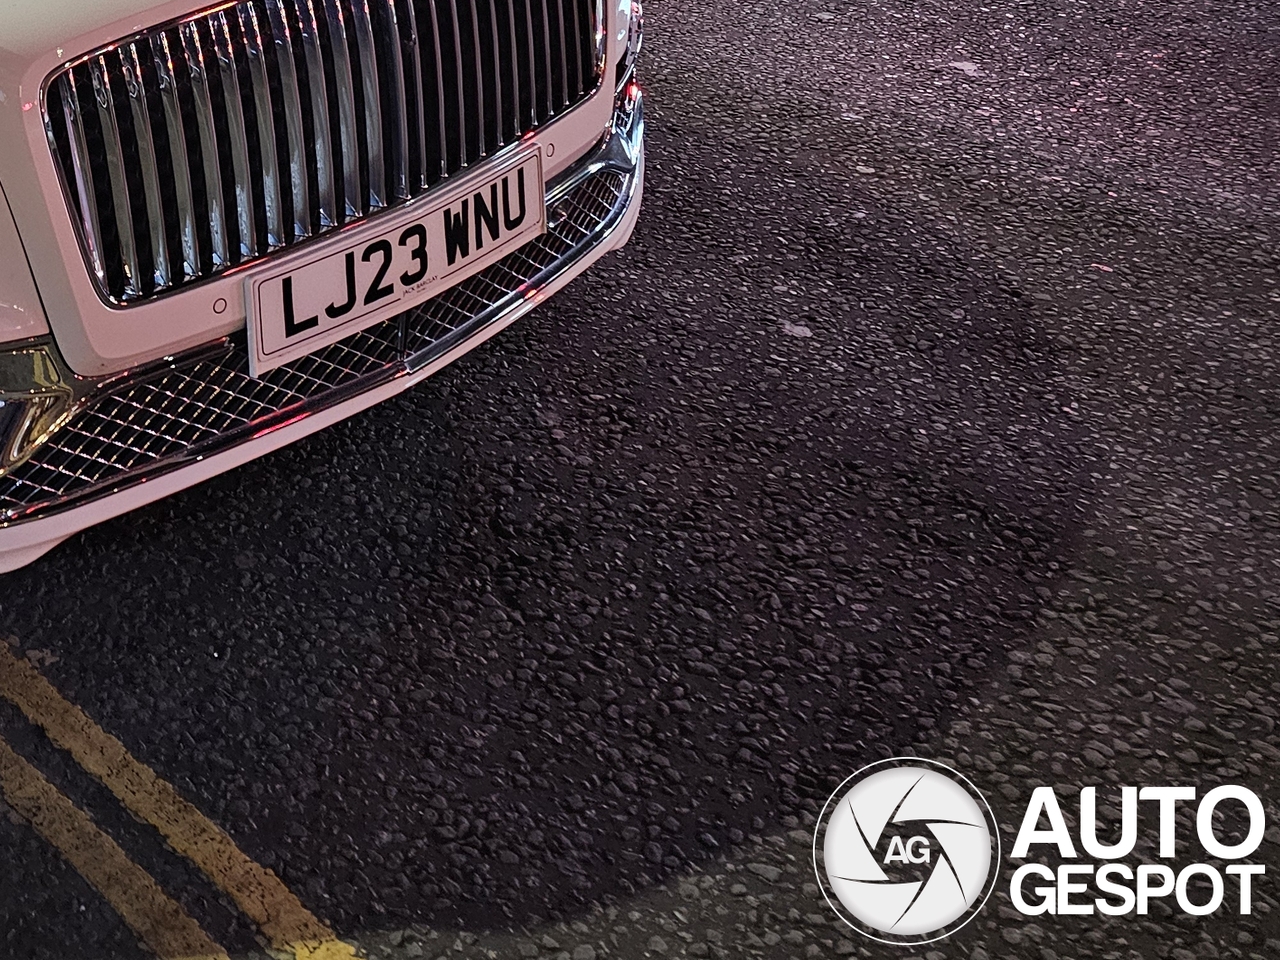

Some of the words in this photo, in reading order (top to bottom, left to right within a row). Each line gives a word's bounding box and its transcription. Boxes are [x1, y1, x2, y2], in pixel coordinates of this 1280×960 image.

[282, 224, 428, 338] LJ23
[443, 168, 525, 266] WNU
[403, 287, 415, 297] JACK
[417, 275, 438, 288] BARCLAY
